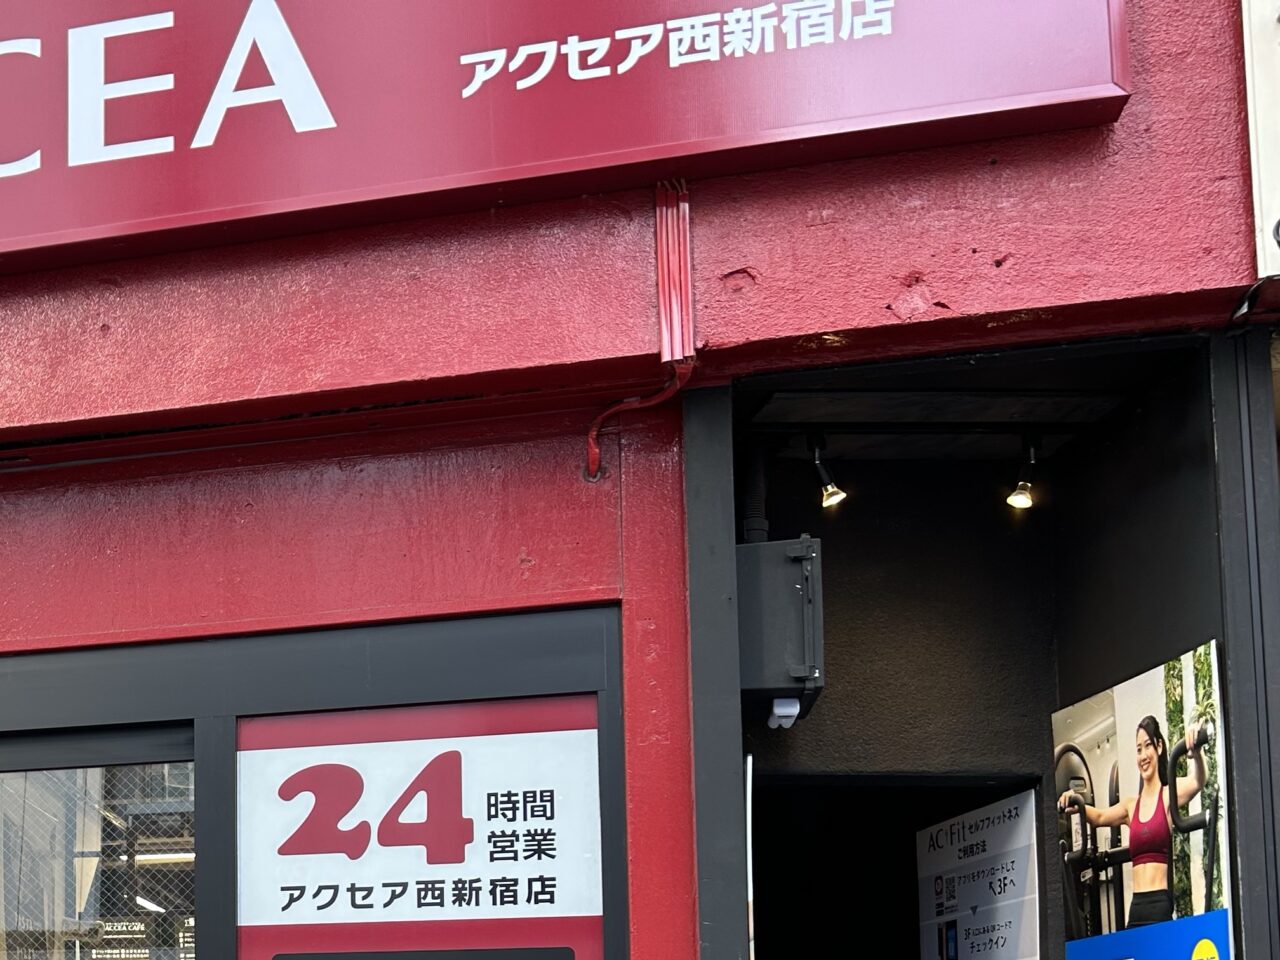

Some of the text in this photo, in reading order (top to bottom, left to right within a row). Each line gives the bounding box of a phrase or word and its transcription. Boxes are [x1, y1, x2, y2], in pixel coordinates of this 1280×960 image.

[459, 0, 896, 99] アクセア西新宿店
[277, 750, 474, 864] 24
[486, 789, 555, 823] 時間
[487, 829, 557, 863] 営業
[280, 875, 557, 912] アクセア西新宿店
[970, 936, 1007, 953] チェックイン
